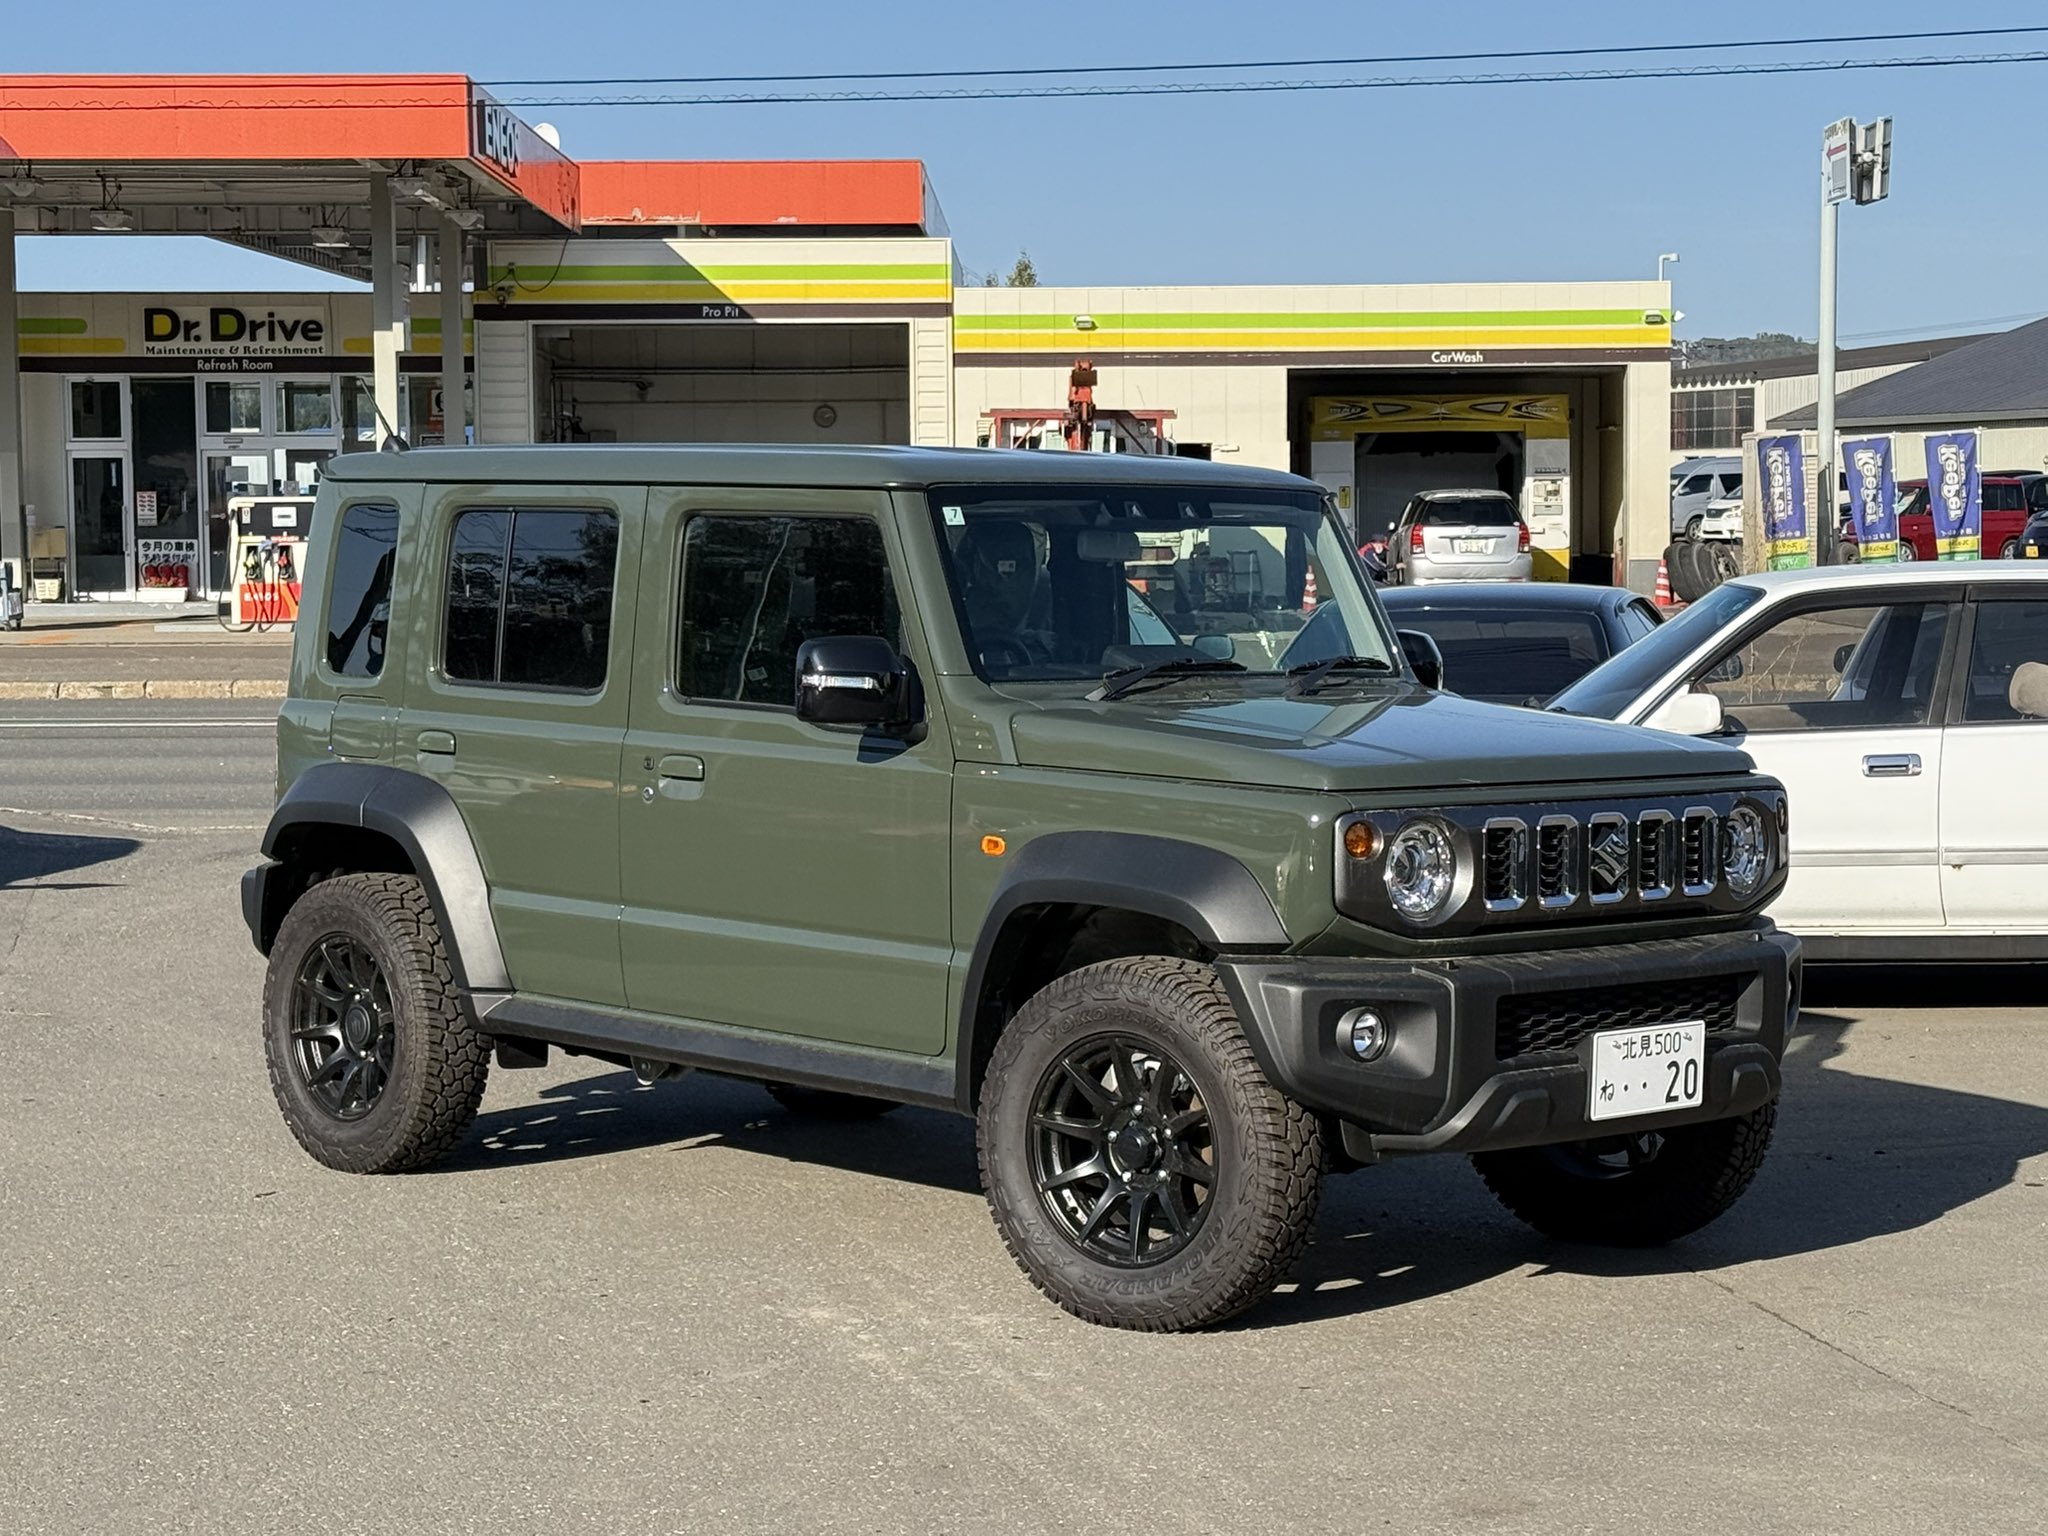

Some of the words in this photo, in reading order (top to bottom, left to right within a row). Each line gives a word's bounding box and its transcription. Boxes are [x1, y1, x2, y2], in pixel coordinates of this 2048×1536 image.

[702, 305, 721, 317] Pro
[144, 307, 202, 342] Dr.
[210, 307, 324, 342] Drive
[145, 345, 225, 355] Maintenance
[229, 345, 239, 355] &
[243, 345, 324, 355] Refreshment
[1431, 350, 1484, 363] CarWash
[197, 358, 239, 371] Refresh
[242, 359, 273, 371] Room
[142, 541, 195, 552] 今月の車検
